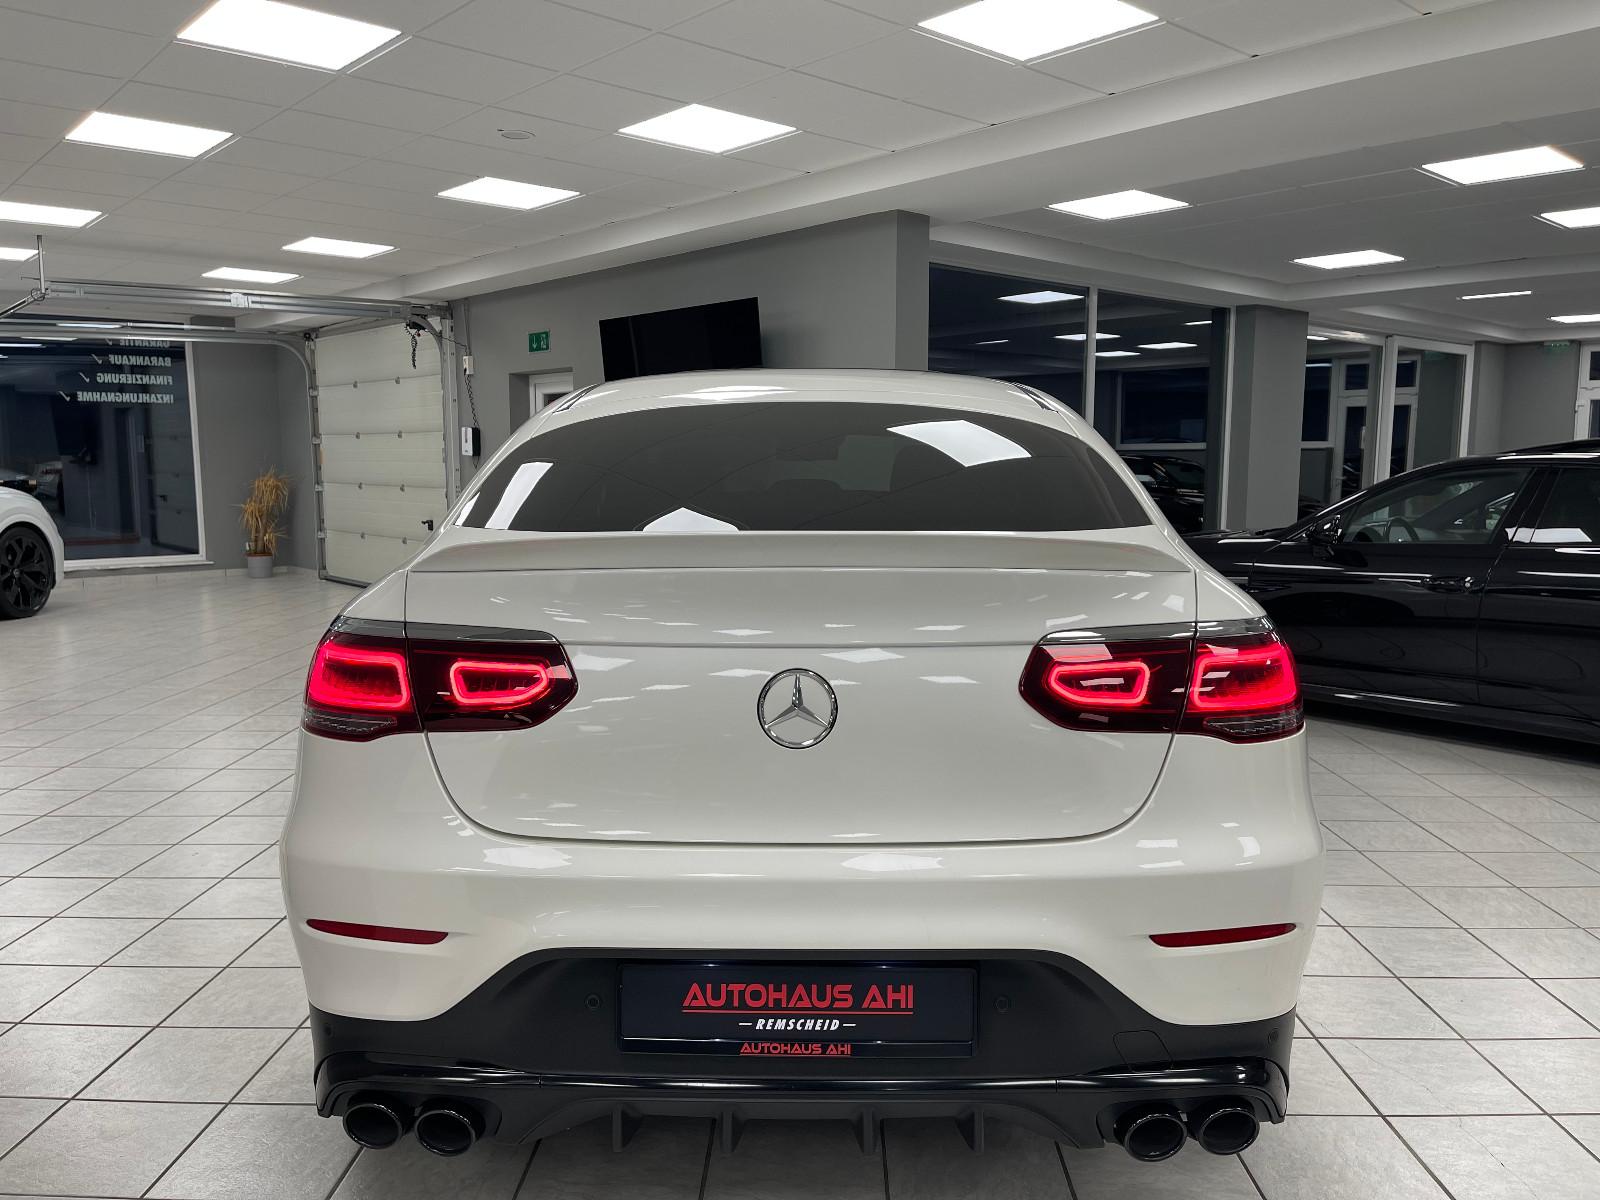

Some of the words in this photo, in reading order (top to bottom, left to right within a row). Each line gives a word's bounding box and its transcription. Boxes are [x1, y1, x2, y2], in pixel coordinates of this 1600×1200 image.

[682, 982, 853, 1009] AUTOHAUS
[862, 984, 914, 1010] AHI
[755, 1018, 840, 1031] REMSCHEID
[740, 1042, 822, 1055] AUTOHAUS
[826, 1043, 852, 1056] AHI
